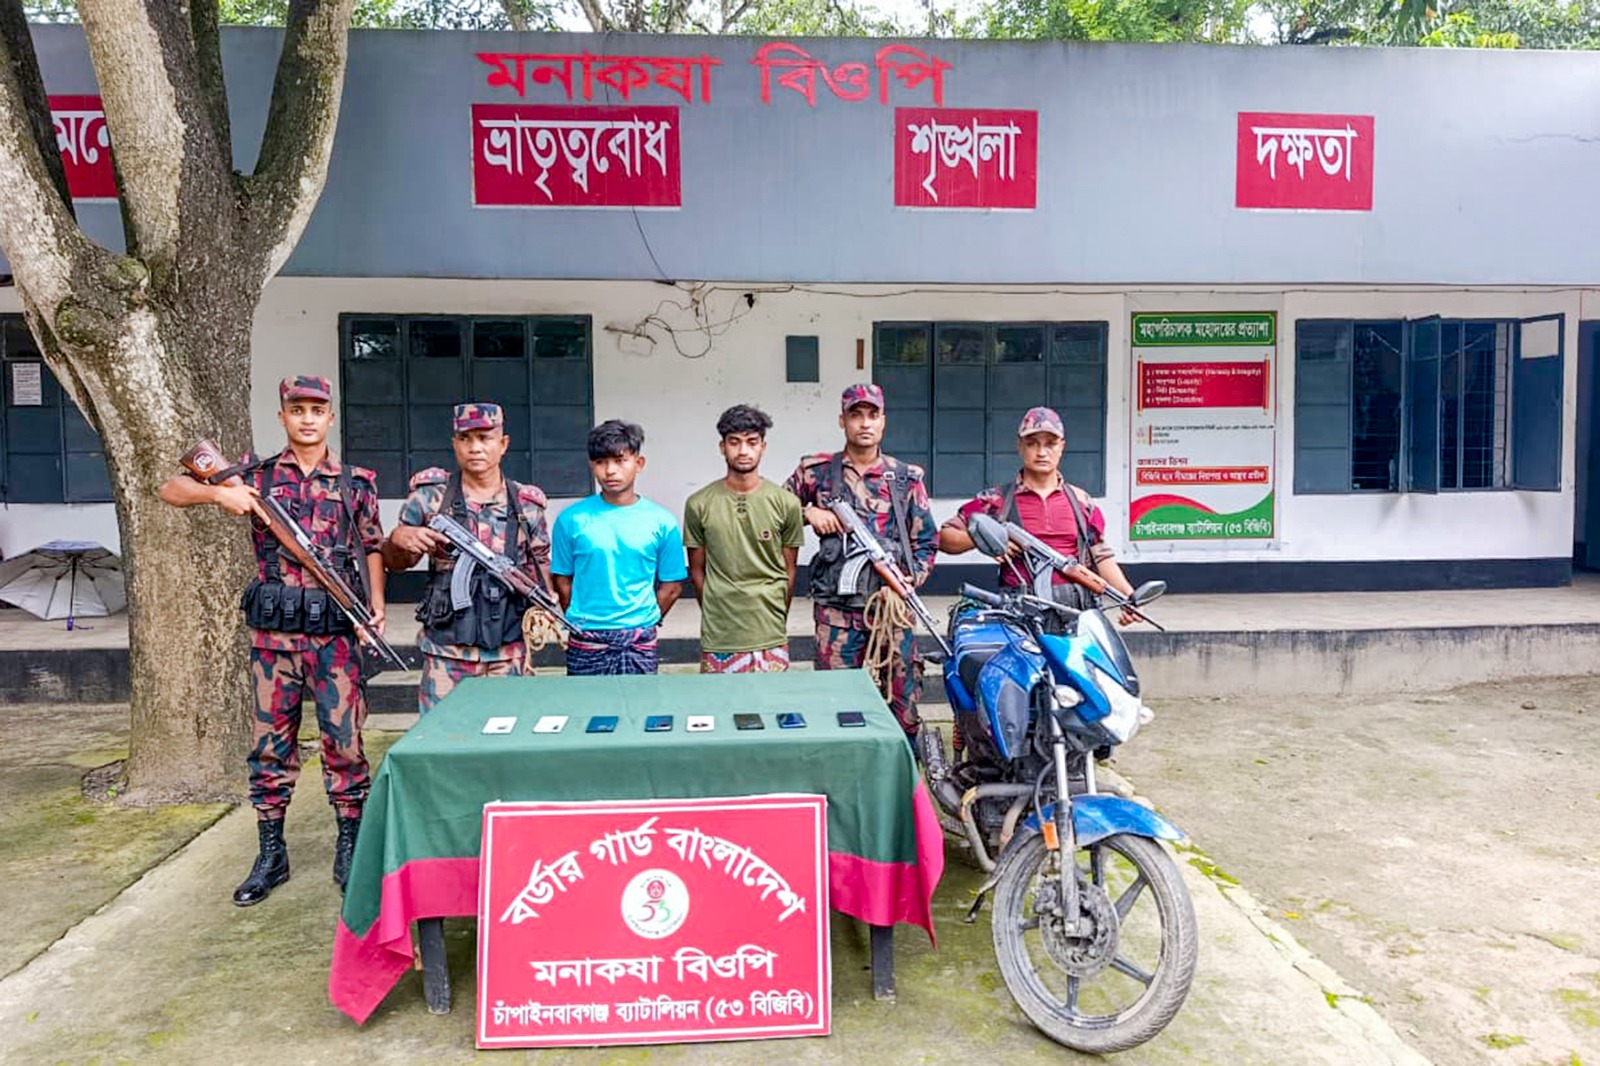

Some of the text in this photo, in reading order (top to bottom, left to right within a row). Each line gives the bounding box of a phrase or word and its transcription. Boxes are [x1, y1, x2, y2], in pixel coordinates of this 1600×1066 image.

[474, 43, 955, 107] মনাকষা বিওপি
[479, 113, 671, 200] ভ্রাতৃত্ববোধ
[907, 117, 1023, 202] শৃঙ্খলা
[1250, 122, 1358, 182] দক্ষতা
[500, 817, 806, 925] বর্ডার গার্ড বাংলাদেশ
[530, 943, 778, 987] মনাকষা বিওপি
[493, 989, 814, 1027] চাঁপাইনবাবগঞ্জ ব্যাটালিয়ন (৫৩ বিজিবি)
